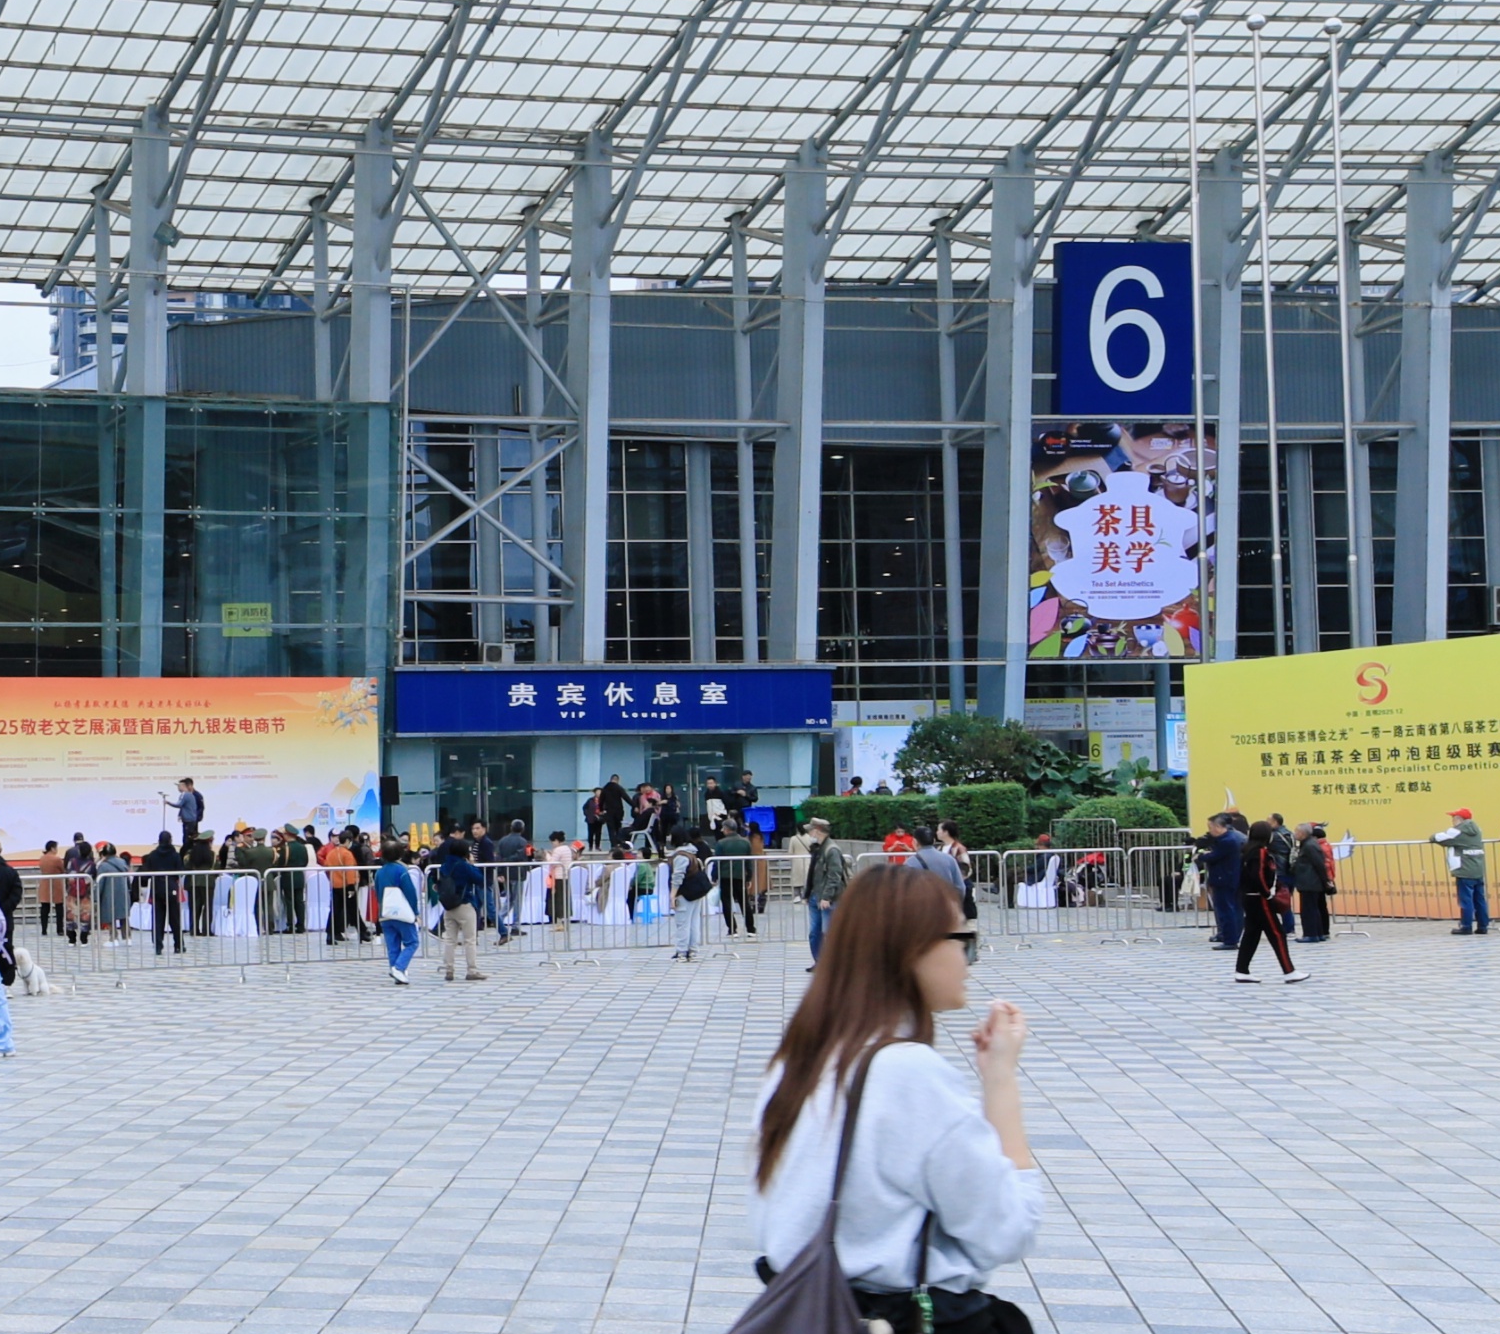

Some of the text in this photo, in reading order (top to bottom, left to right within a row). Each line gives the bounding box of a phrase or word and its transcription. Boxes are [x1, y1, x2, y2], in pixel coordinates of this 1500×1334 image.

[1089, 265, 1166, 392] 6
[1092, 504, 1156, 536] 茶具
[1091, 541, 1155, 574] 美学
[1091, 579, 1154, 587] Tea Set Aesthetics
[508, 682, 728, 707] 贵宾休息室
[621, 711, 678, 720] Lounge
[1091, 744, 1101, 758] 6
[1298, 767, 1336, 776] Yunnan
[1376, 763, 1431, 774] Specialist
